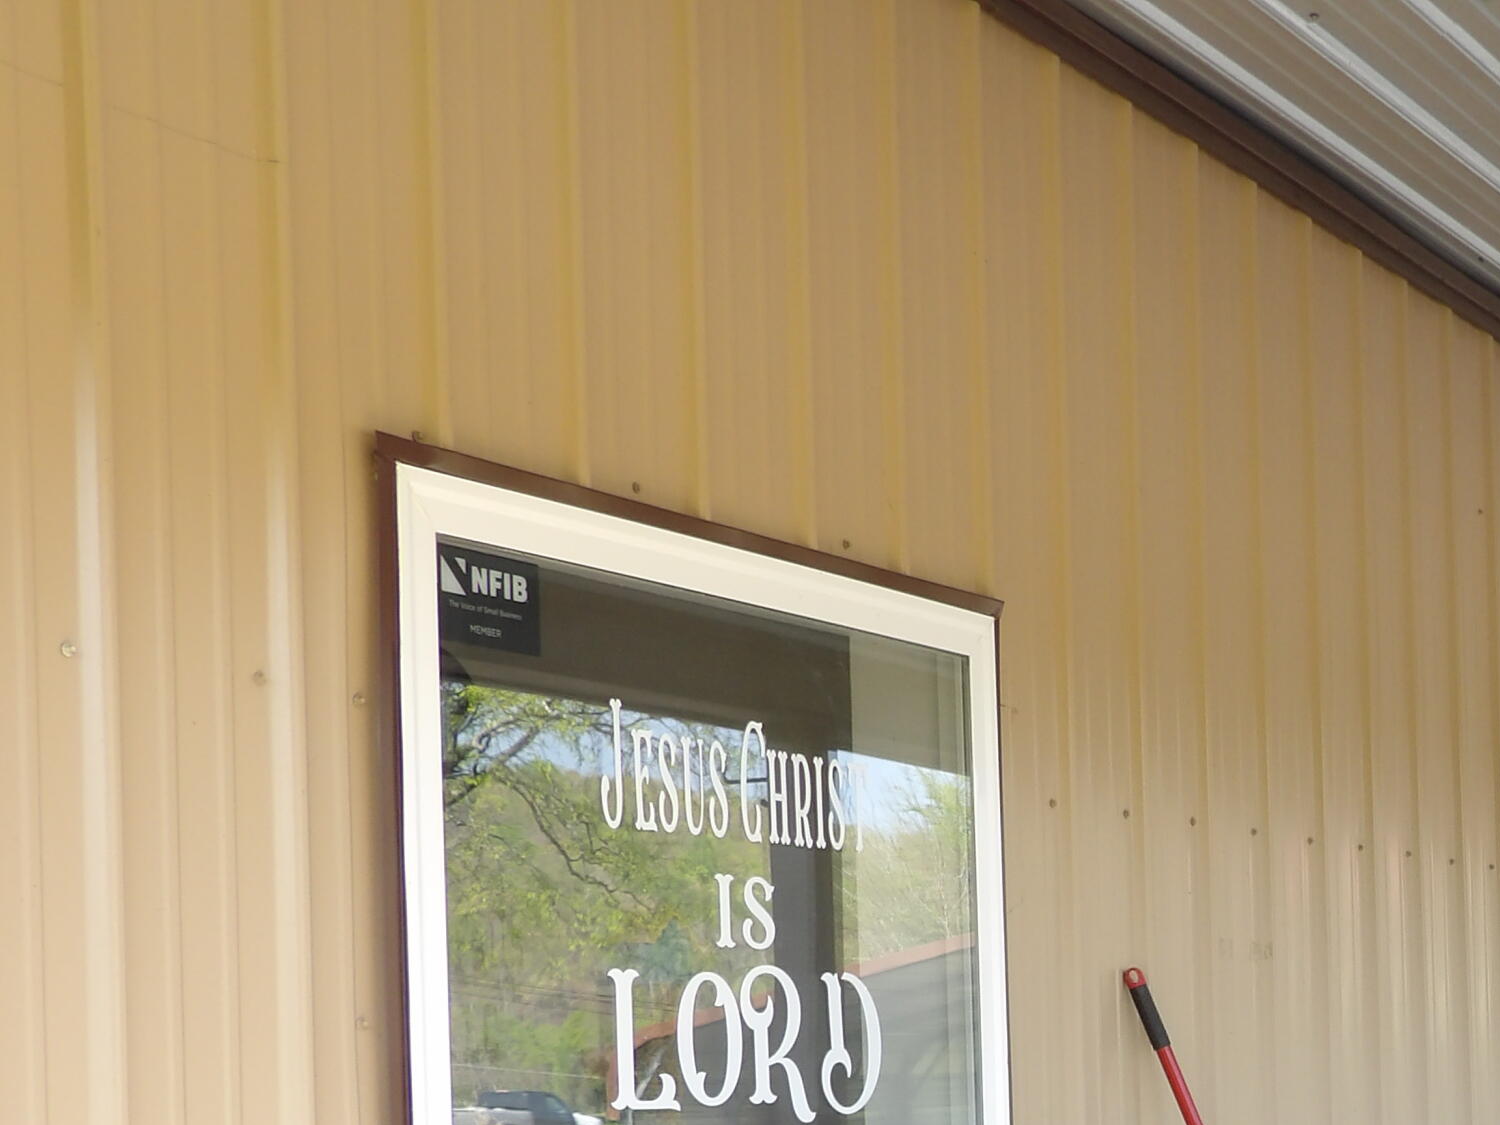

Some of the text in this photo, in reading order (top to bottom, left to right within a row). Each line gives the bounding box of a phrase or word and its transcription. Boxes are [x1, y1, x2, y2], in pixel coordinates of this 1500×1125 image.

[471, 565, 528, 603] NFIB
[470, 624, 502, 638] MEMBER
[714, 873, 776, 949] IS
[607, 965, 882, 1123] LORD
